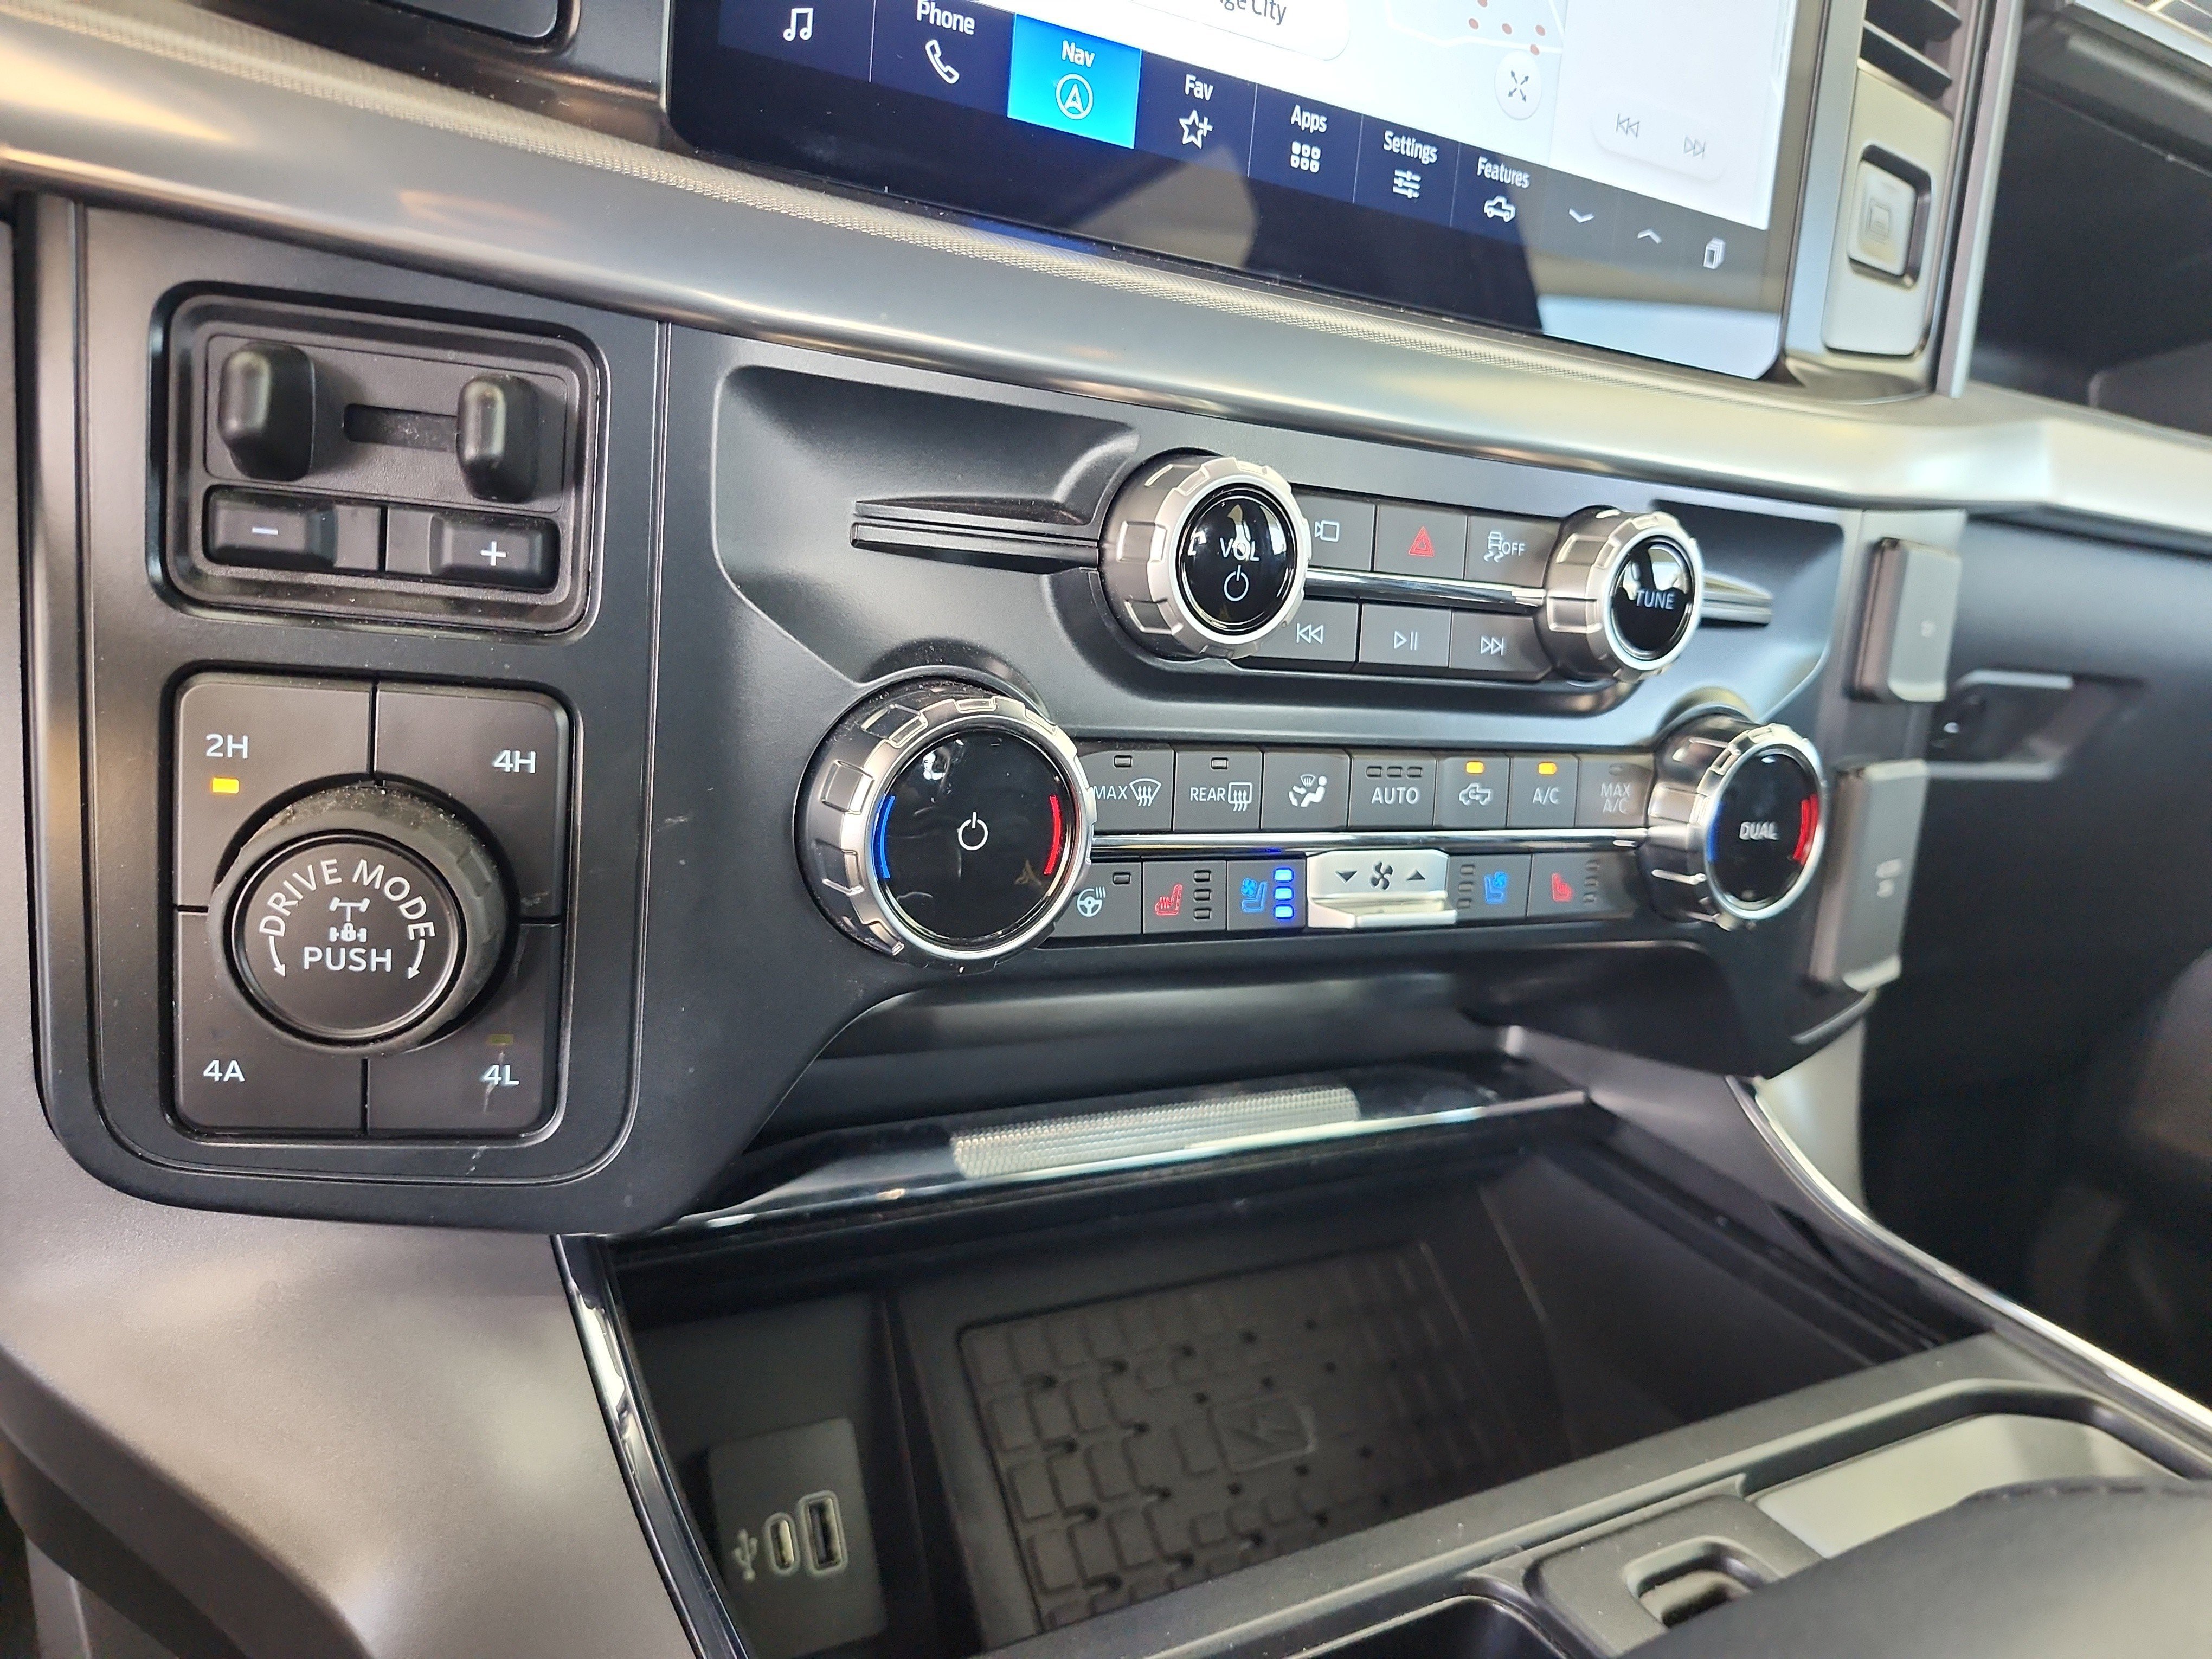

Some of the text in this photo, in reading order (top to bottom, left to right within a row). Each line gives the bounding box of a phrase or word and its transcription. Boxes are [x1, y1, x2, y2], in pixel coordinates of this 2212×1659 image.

[916, 0, 975, 35] Phone
[1252, 0, 1287, 25] City
[1061, 40, 1095, 68] Nav
[1185, 74, 1213, 101] Fav
[1290, 104, 1327, 133] Apps
[1383, 130, 1438, 164] Settings
[1476, 156, 1530, 189] Features
[1219, 537, 1259, 561] VOL
[1502, 542, 1525, 556] OFF
[1636, 589, 1674, 610] TUNE
[205, 734, 249, 759] 2H
[492, 750, 536, 774] 4H
[1092, 786, 1128, 800] MAX
[1189, 787, 1225, 801] REAR
[1371, 786, 1421, 805] AUTO
[1532, 786, 1560, 805] A/C
[1600, 783, 1631, 798] MAX
[1602, 798, 1628, 814] A/C
[1739, 821, 1779, 840] DUAL
[259, 859, 435, 941] DRIVE MODE
[303, 946, 392, 972] PUSH
[203, 1059, 245, 1083] 4A
[482, 1065, 519, 1086] 4L
